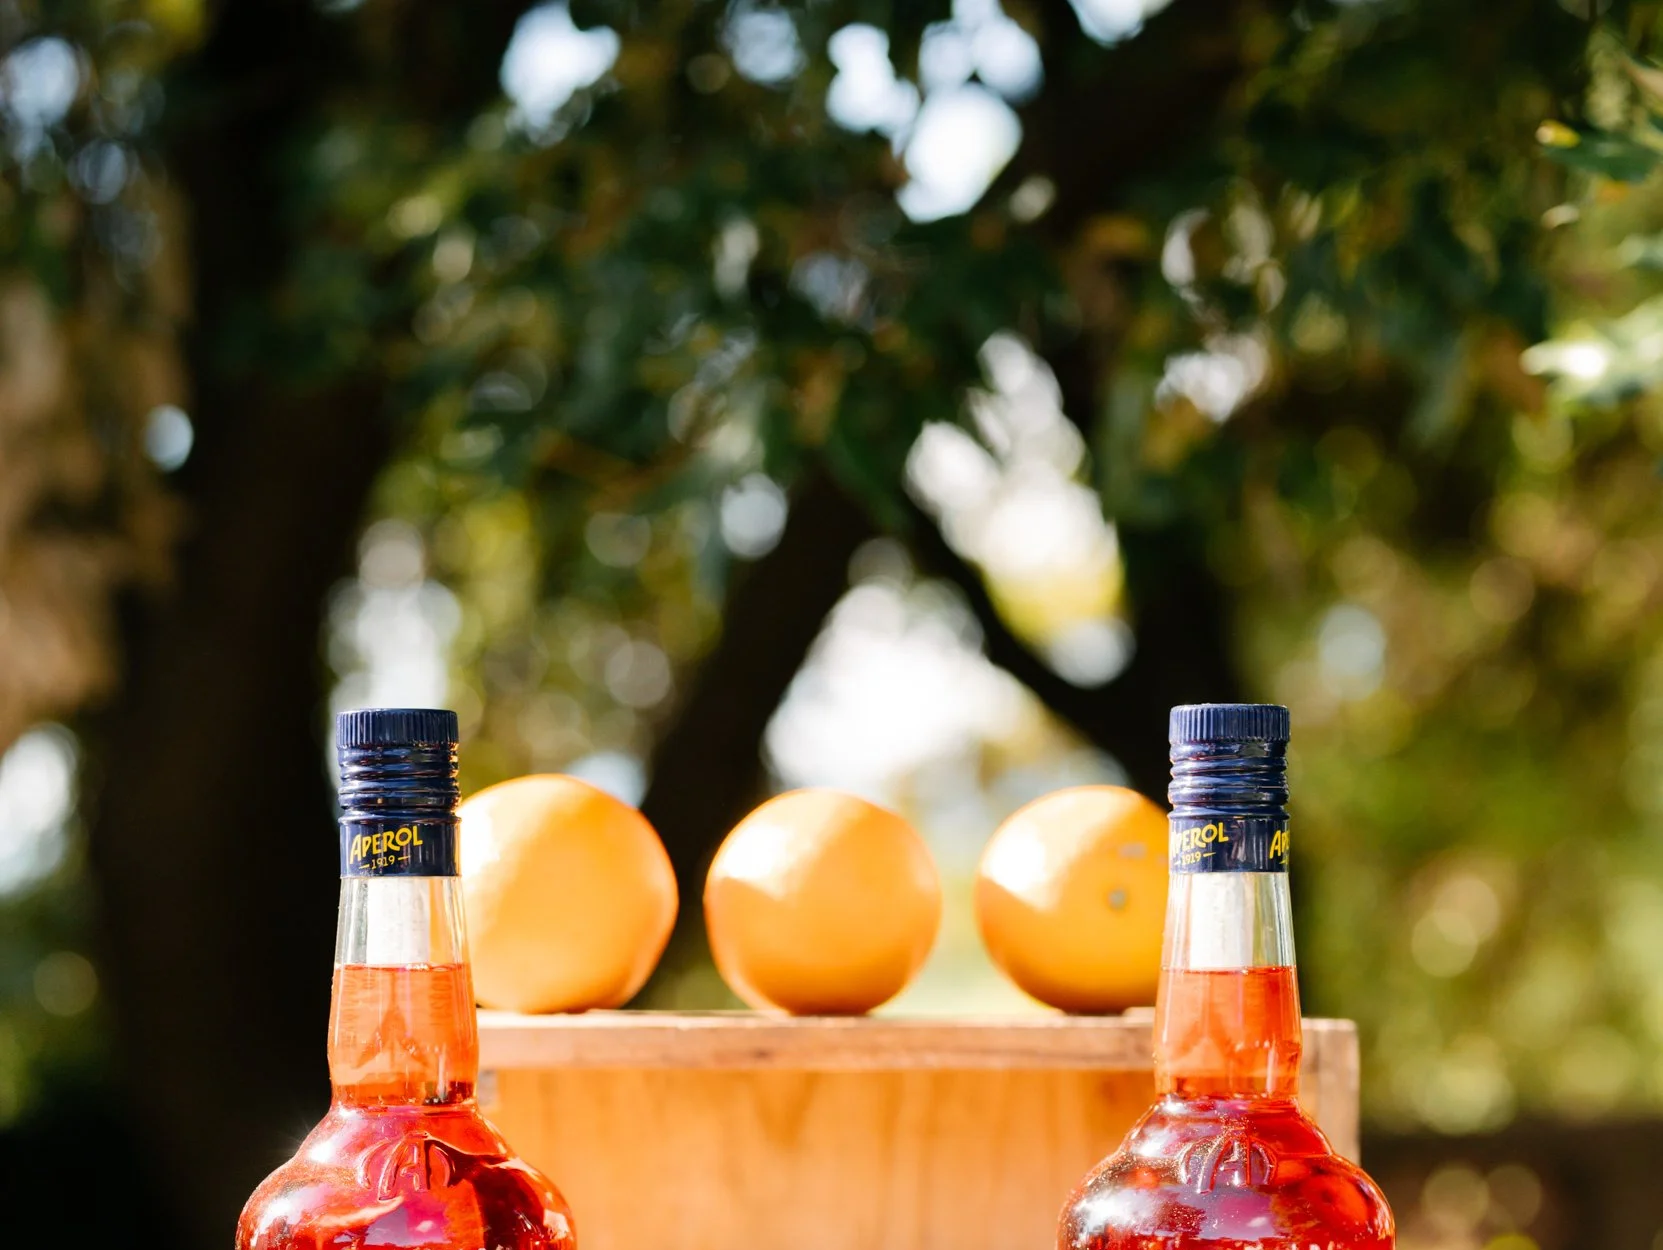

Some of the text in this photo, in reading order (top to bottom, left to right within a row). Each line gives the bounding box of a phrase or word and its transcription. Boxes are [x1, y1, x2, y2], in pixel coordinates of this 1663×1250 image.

[350, 825, 423, 865] APEROL
[371, 854, 396, 870] 1919
[1181, 851, 1202, 866] 1919
